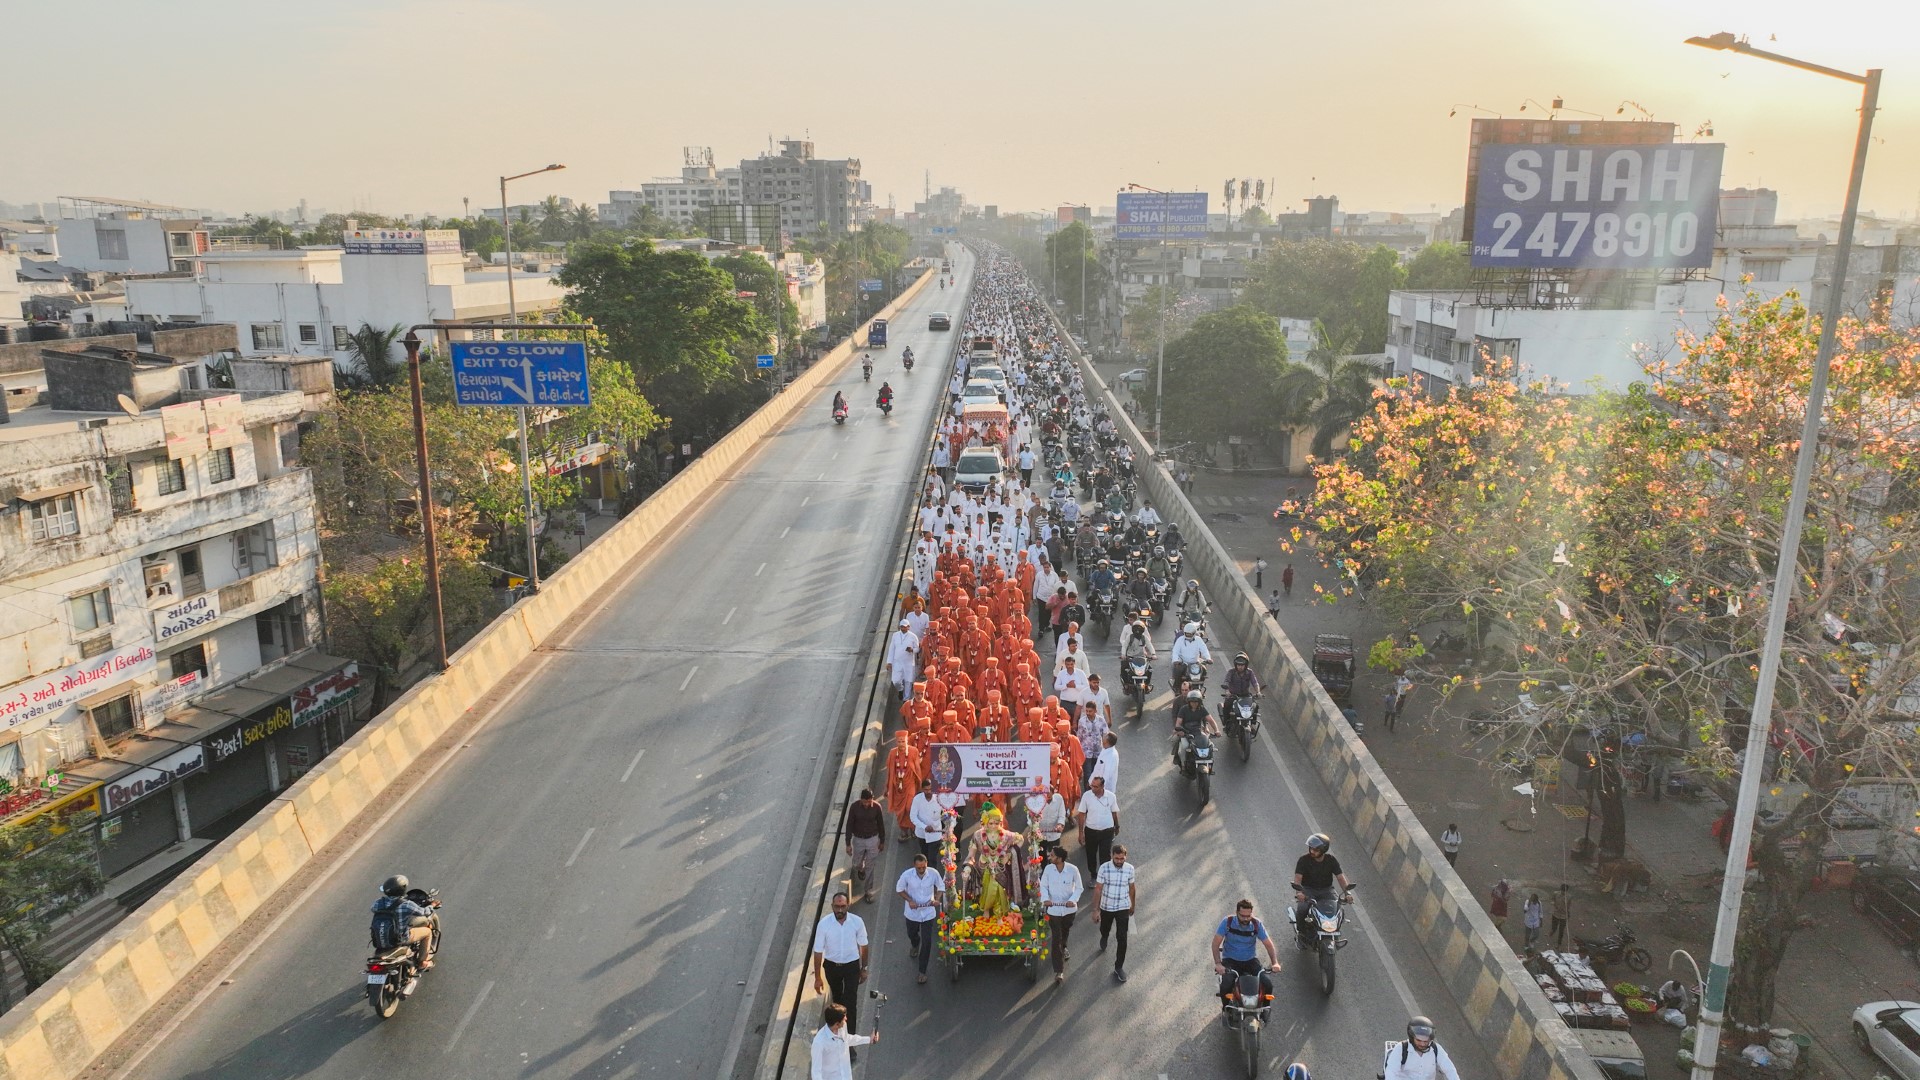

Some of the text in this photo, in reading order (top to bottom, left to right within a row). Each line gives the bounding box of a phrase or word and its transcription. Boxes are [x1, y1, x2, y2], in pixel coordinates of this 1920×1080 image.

[1502, 149, 1695, 202] SHAH
[1130, 211, 1206, 222] SHAH PUBLICITY
[1490, 211, 1699, 258] 2478910
[469, 346, 566, 355] GO SLOW
[463, 358, 519, 368] EXIT TO
[161, 609, 216, 638] લેબોરેટરી
[32, 682, 56, 702] અને
[60, 661, 112, 693] સોનોગ્રાફી
[47, 699, 63, 711] શાહ
[975, 760, 1027, 770] પદયાત્રા
